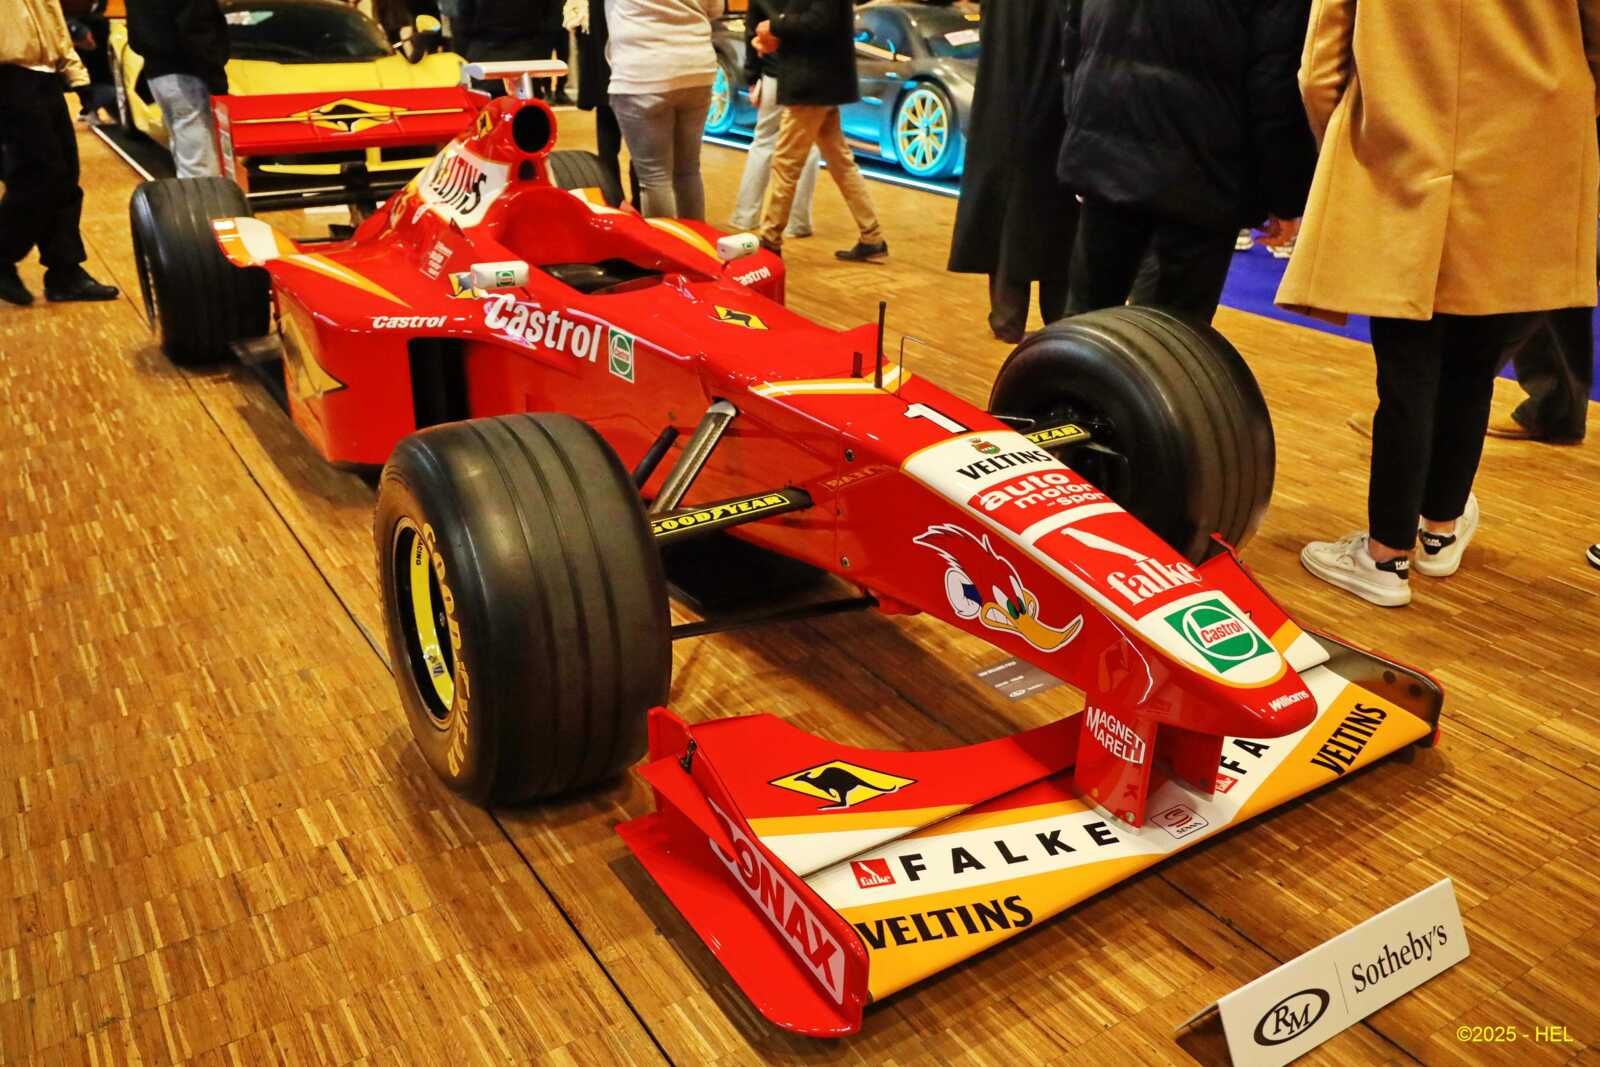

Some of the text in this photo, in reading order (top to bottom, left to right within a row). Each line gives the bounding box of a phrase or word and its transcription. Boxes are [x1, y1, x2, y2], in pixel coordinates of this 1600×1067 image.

[372, 315, 448, 328] Castrol
[484, 293, 602, 362] Castrol
[903, 403, 968, 433] 1
[956, 450, 1053, 480] VELTINS
[979, 473, 1070, 511] auto
[1014, 483, 1093, 509] motor
[1106, 558, 1202, 606] falke
[1200, 619, 1244, 644] Castrol
[1268, 690, 1310, 712] Williams
[1310, 703, 1387, 776] VELTINS
[898, 820, 1120, 882] FALKE
[854, 895, 1033, 951] VELTINS
[1271, 924, 1448, 1036] RM Sotheby's
